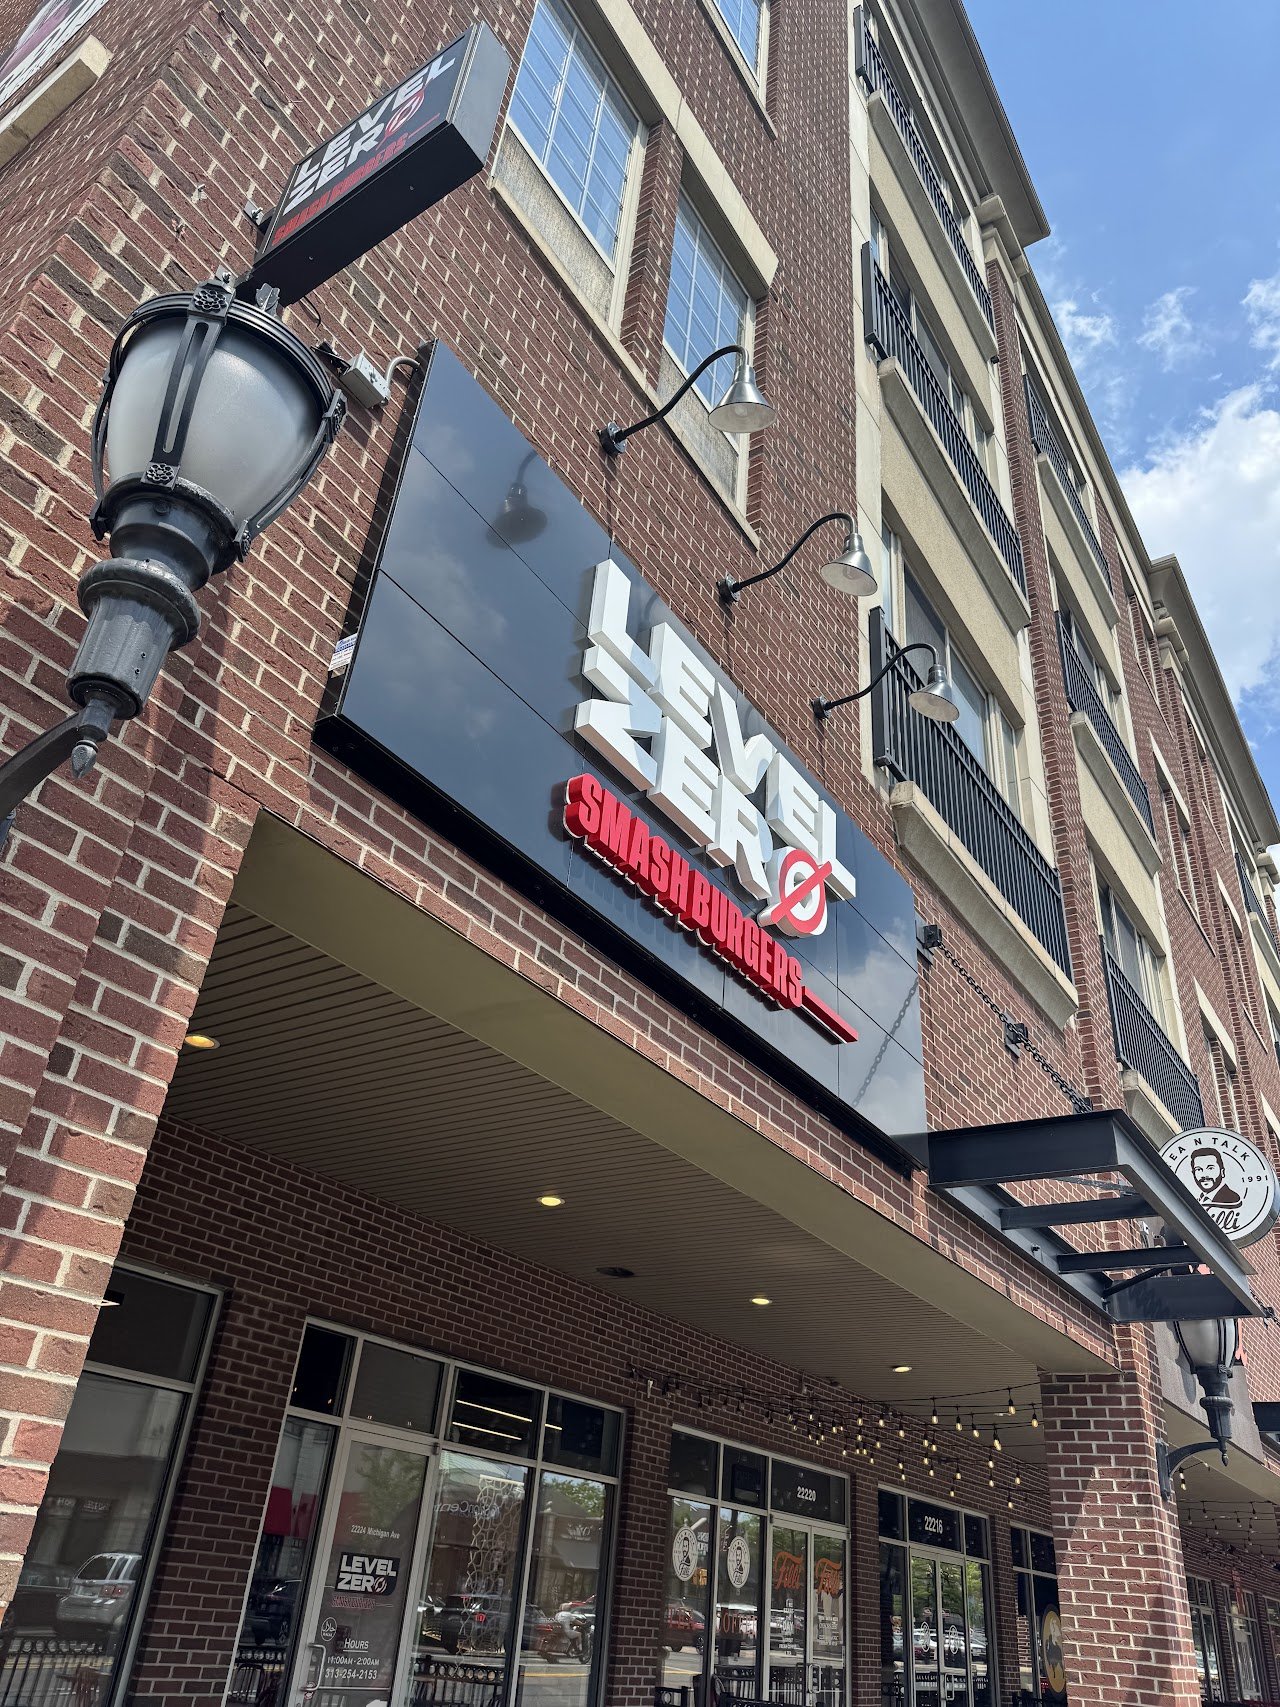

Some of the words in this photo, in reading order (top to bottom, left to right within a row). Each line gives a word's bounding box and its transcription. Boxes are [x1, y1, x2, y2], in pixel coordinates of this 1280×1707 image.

[293, 55, 455, 185] LEVEL
[588, 558, 857, 901] LEVEL
[566, 772, 696, 924] SMASH
[689, 878, 804, 1008] BURGERS
[1168, 1146, 1186, 1161] EA
[1211, 1137, 1250, 1161] TALK
[1241, 1175, 1269, 1183] 1991
[796, 1486, 817, 1502] 22220
[367, 1527, 390, 1539] Michigan
[390, 1529, 400, 1539] Ave
[924, 1515, 944, 1535] 22216
[340, 1554, 397, 1577] LEVEL
[344, 1638, 369, 1650] HOURS
[325, 1668, 378, 1680] 313-254-2153
